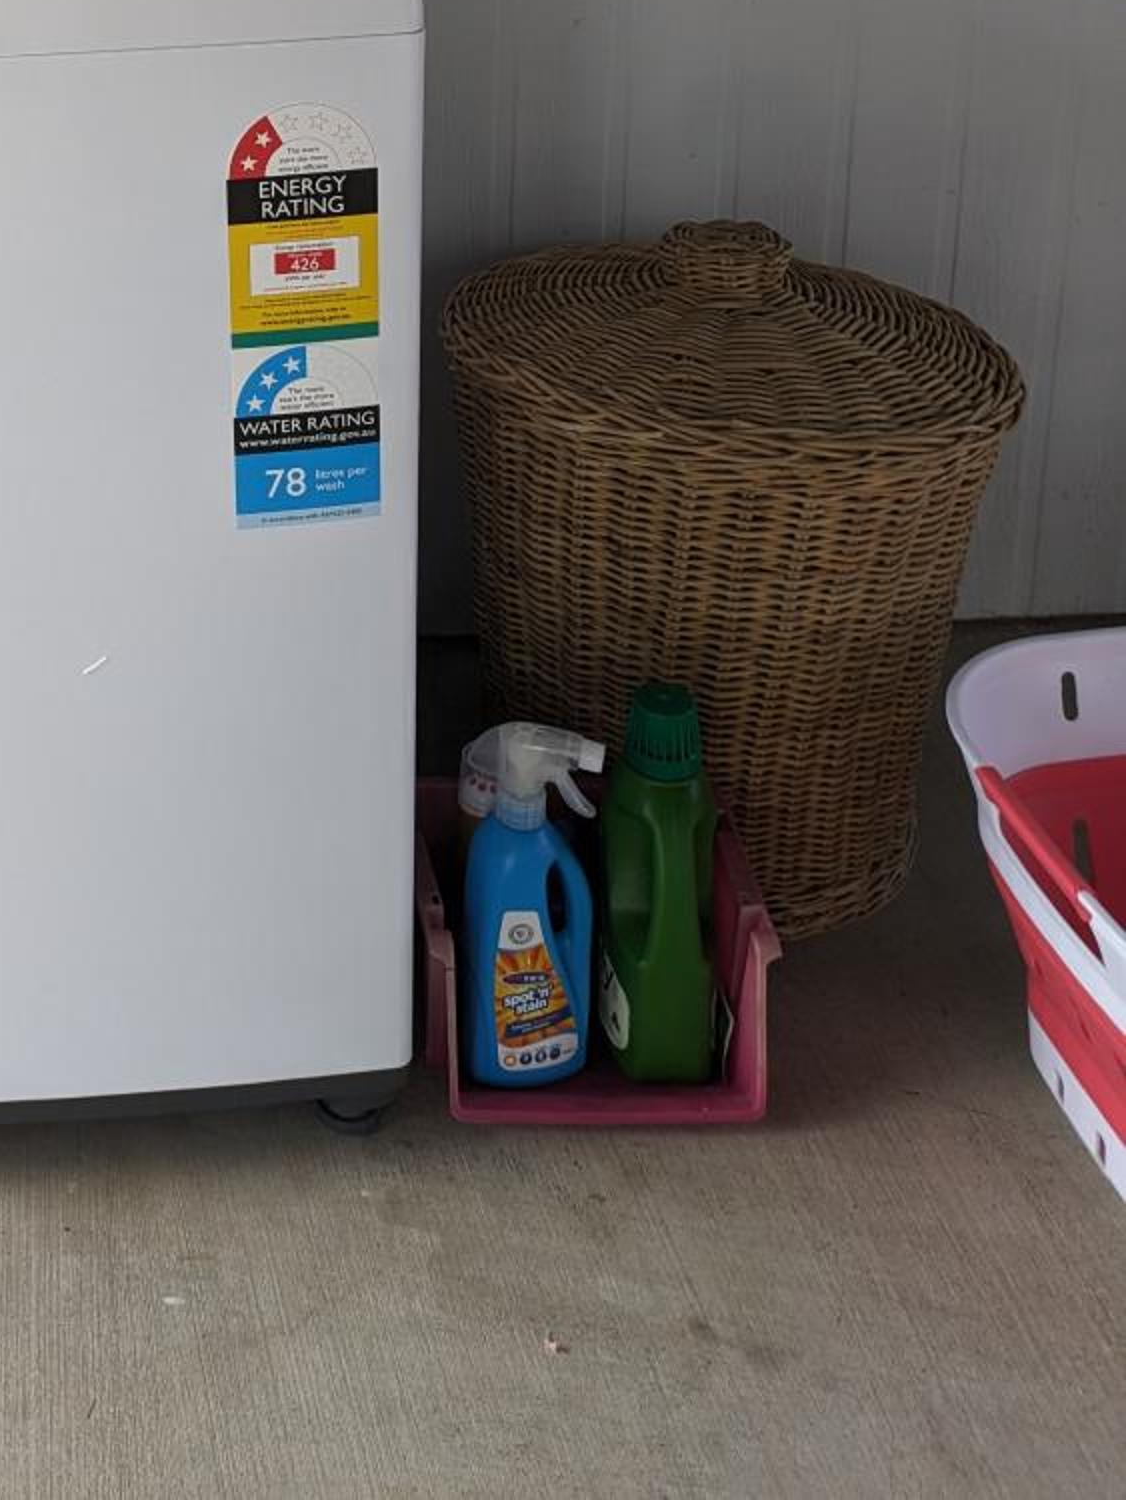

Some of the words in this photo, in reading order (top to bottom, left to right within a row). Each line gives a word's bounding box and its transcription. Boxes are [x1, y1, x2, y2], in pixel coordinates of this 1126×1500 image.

[258, 174, 347, 199] ENERGY
[260, 196, 345, 219] RATING
[290, 257, 320, 271] 426
[238, 419, 303, 436] WATER
[307, 410, 376, 431] RATING
[238, 429, 376, 448] www.waterrating.gov.au
[265, 466, 308, 499] 78
[347, 467, 367, 479] per
[315, 480, 345, 492] wash
[503, 990, 534, 1011] spot
[515, 998, 548, 1014] stain
